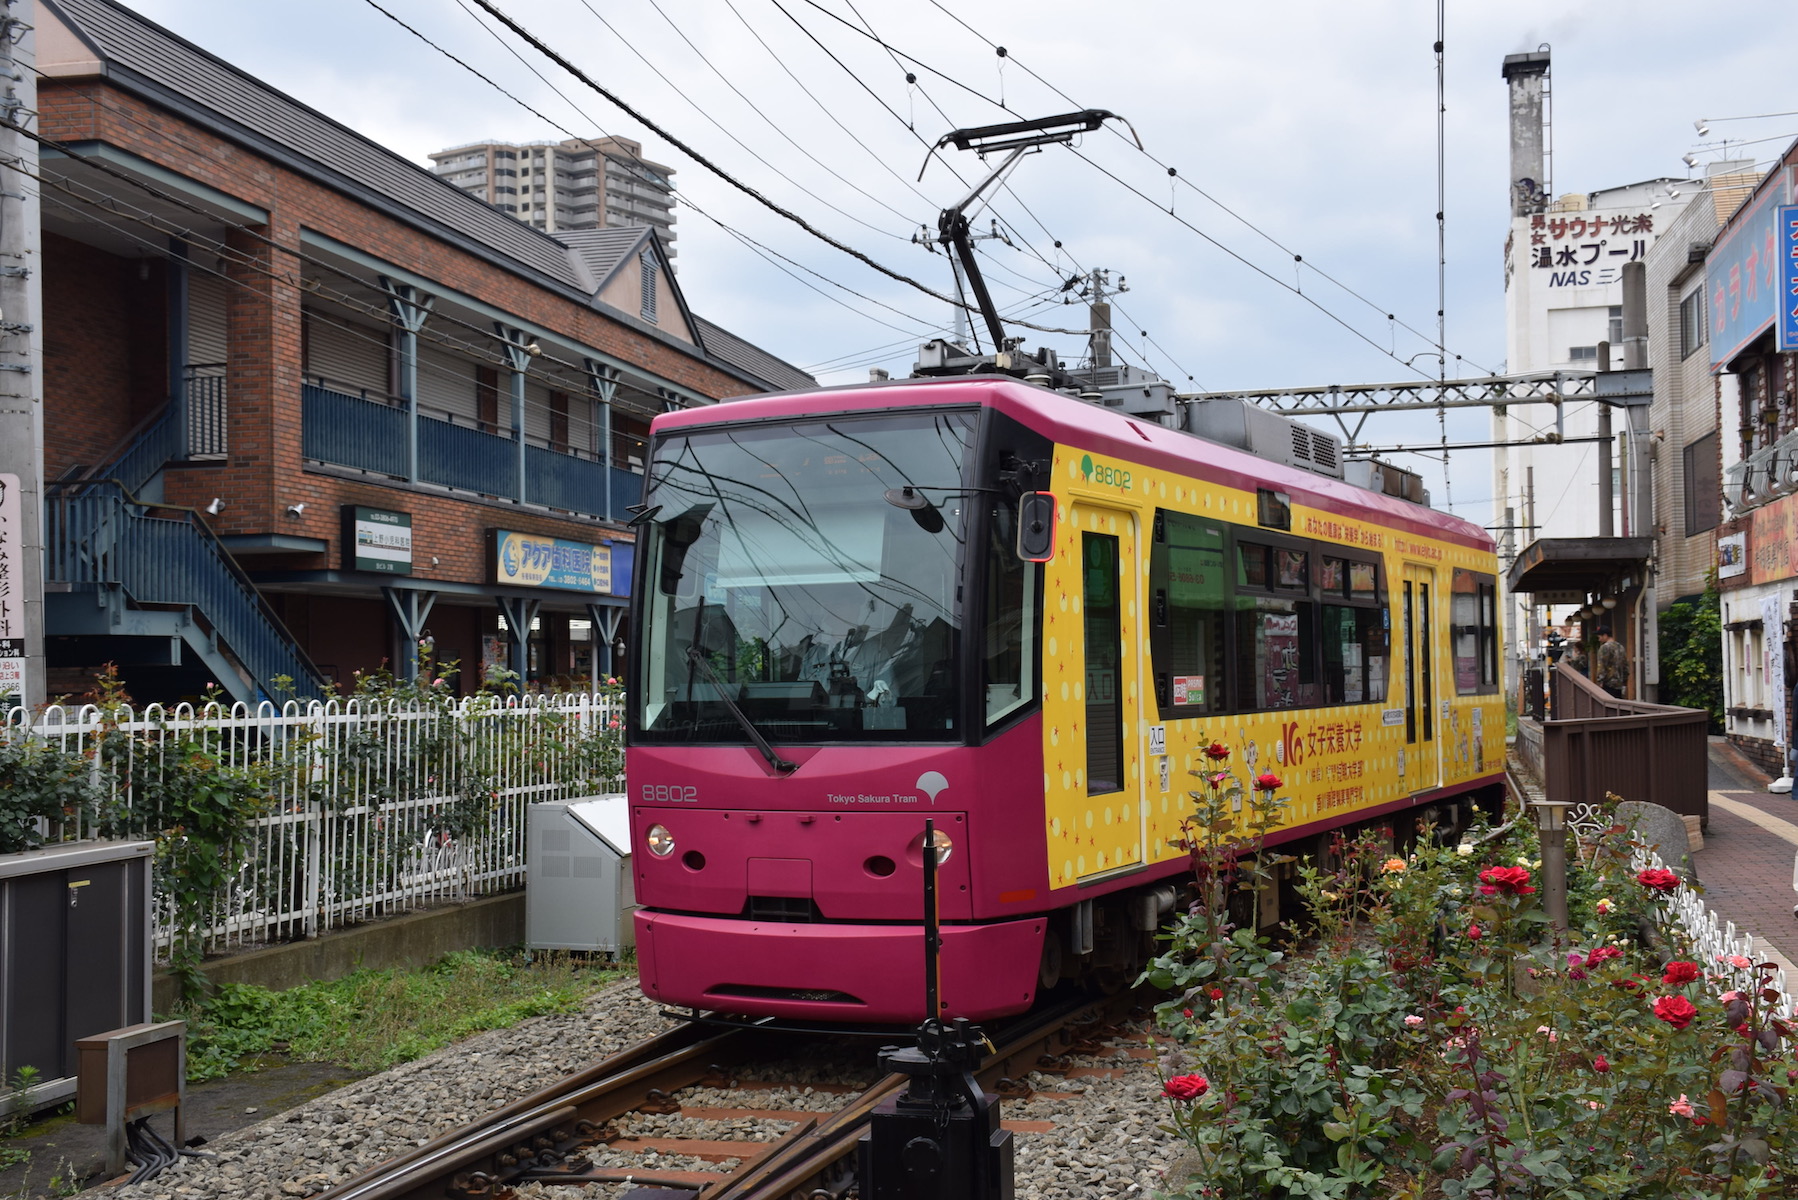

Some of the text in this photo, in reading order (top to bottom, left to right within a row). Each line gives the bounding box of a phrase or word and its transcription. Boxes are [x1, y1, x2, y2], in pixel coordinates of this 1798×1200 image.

[1532, 240, 1645, 268] 温水プール
[1549, 270, 1591, 287] NAS
[1714, 228, 1774, 336] カラオケ
[1095, 464, 1131, 490] 8802
[521, 541, 591, 576] アクア歯科医院
[1150, 727, 1165, 746] 入口
[1307, 720, 1362, 758] 女子栄養大学
[642, 784, 698, 802] 8802
[827, 794, 917, 804] Tokyo Sakura Tram
